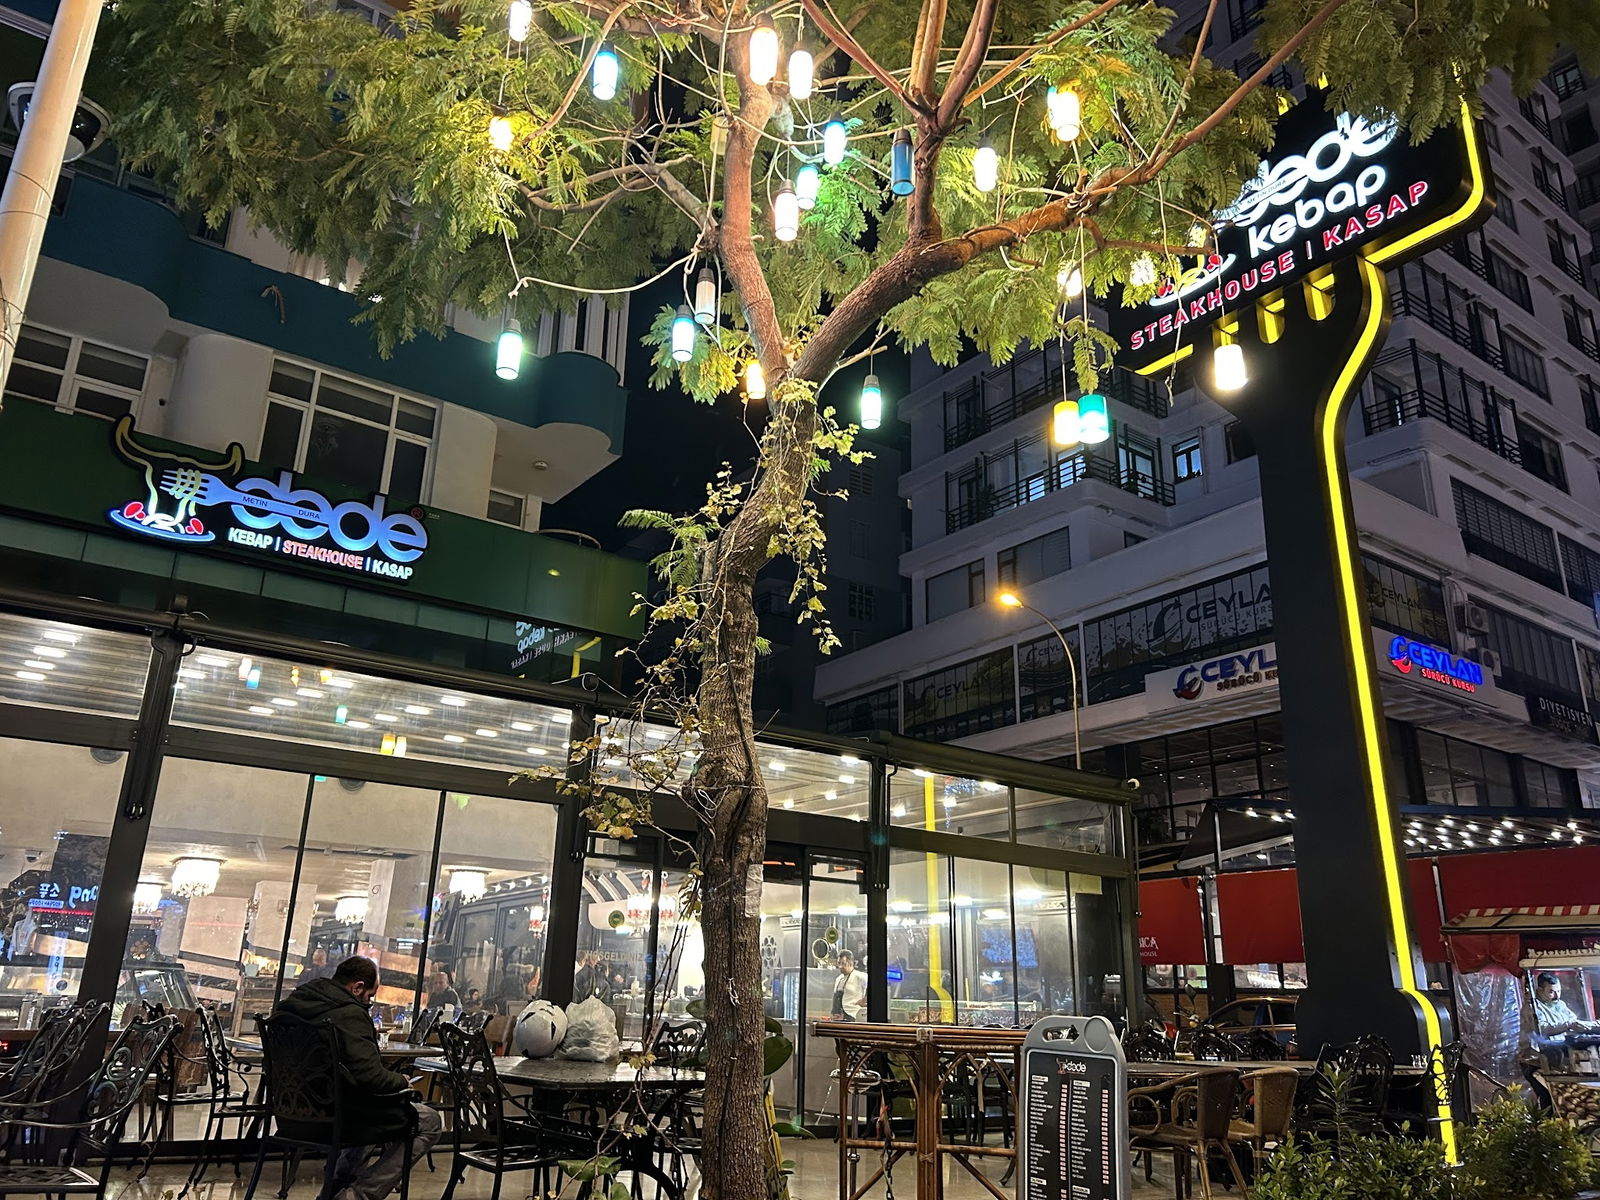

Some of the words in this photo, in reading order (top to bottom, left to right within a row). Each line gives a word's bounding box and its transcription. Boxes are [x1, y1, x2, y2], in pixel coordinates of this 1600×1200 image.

[1249, 165, 1387, 259] kebap
[1131, 250, 1296, 351] STEAKHOUSE
[1322, 180, 1429, 252] KASAP
[231, 471, 428, 563] dede
[298, 509, 320, 519] DURA
[228, 527, 273, 549] KEBAP
[282, 539, 363, 570] STEAKHOUSE
[371, 559, 414, 580] KASAP
[1186, 583, 1271, 623] CEYLA
[1201, 649, 1277, 683] CEYL
[1408, 641, 1483, 686] CEYLAN
[1421, 667, 1451, 685] SÜRÜCÜ
[1452, 677, 1476, 694] KURSU
